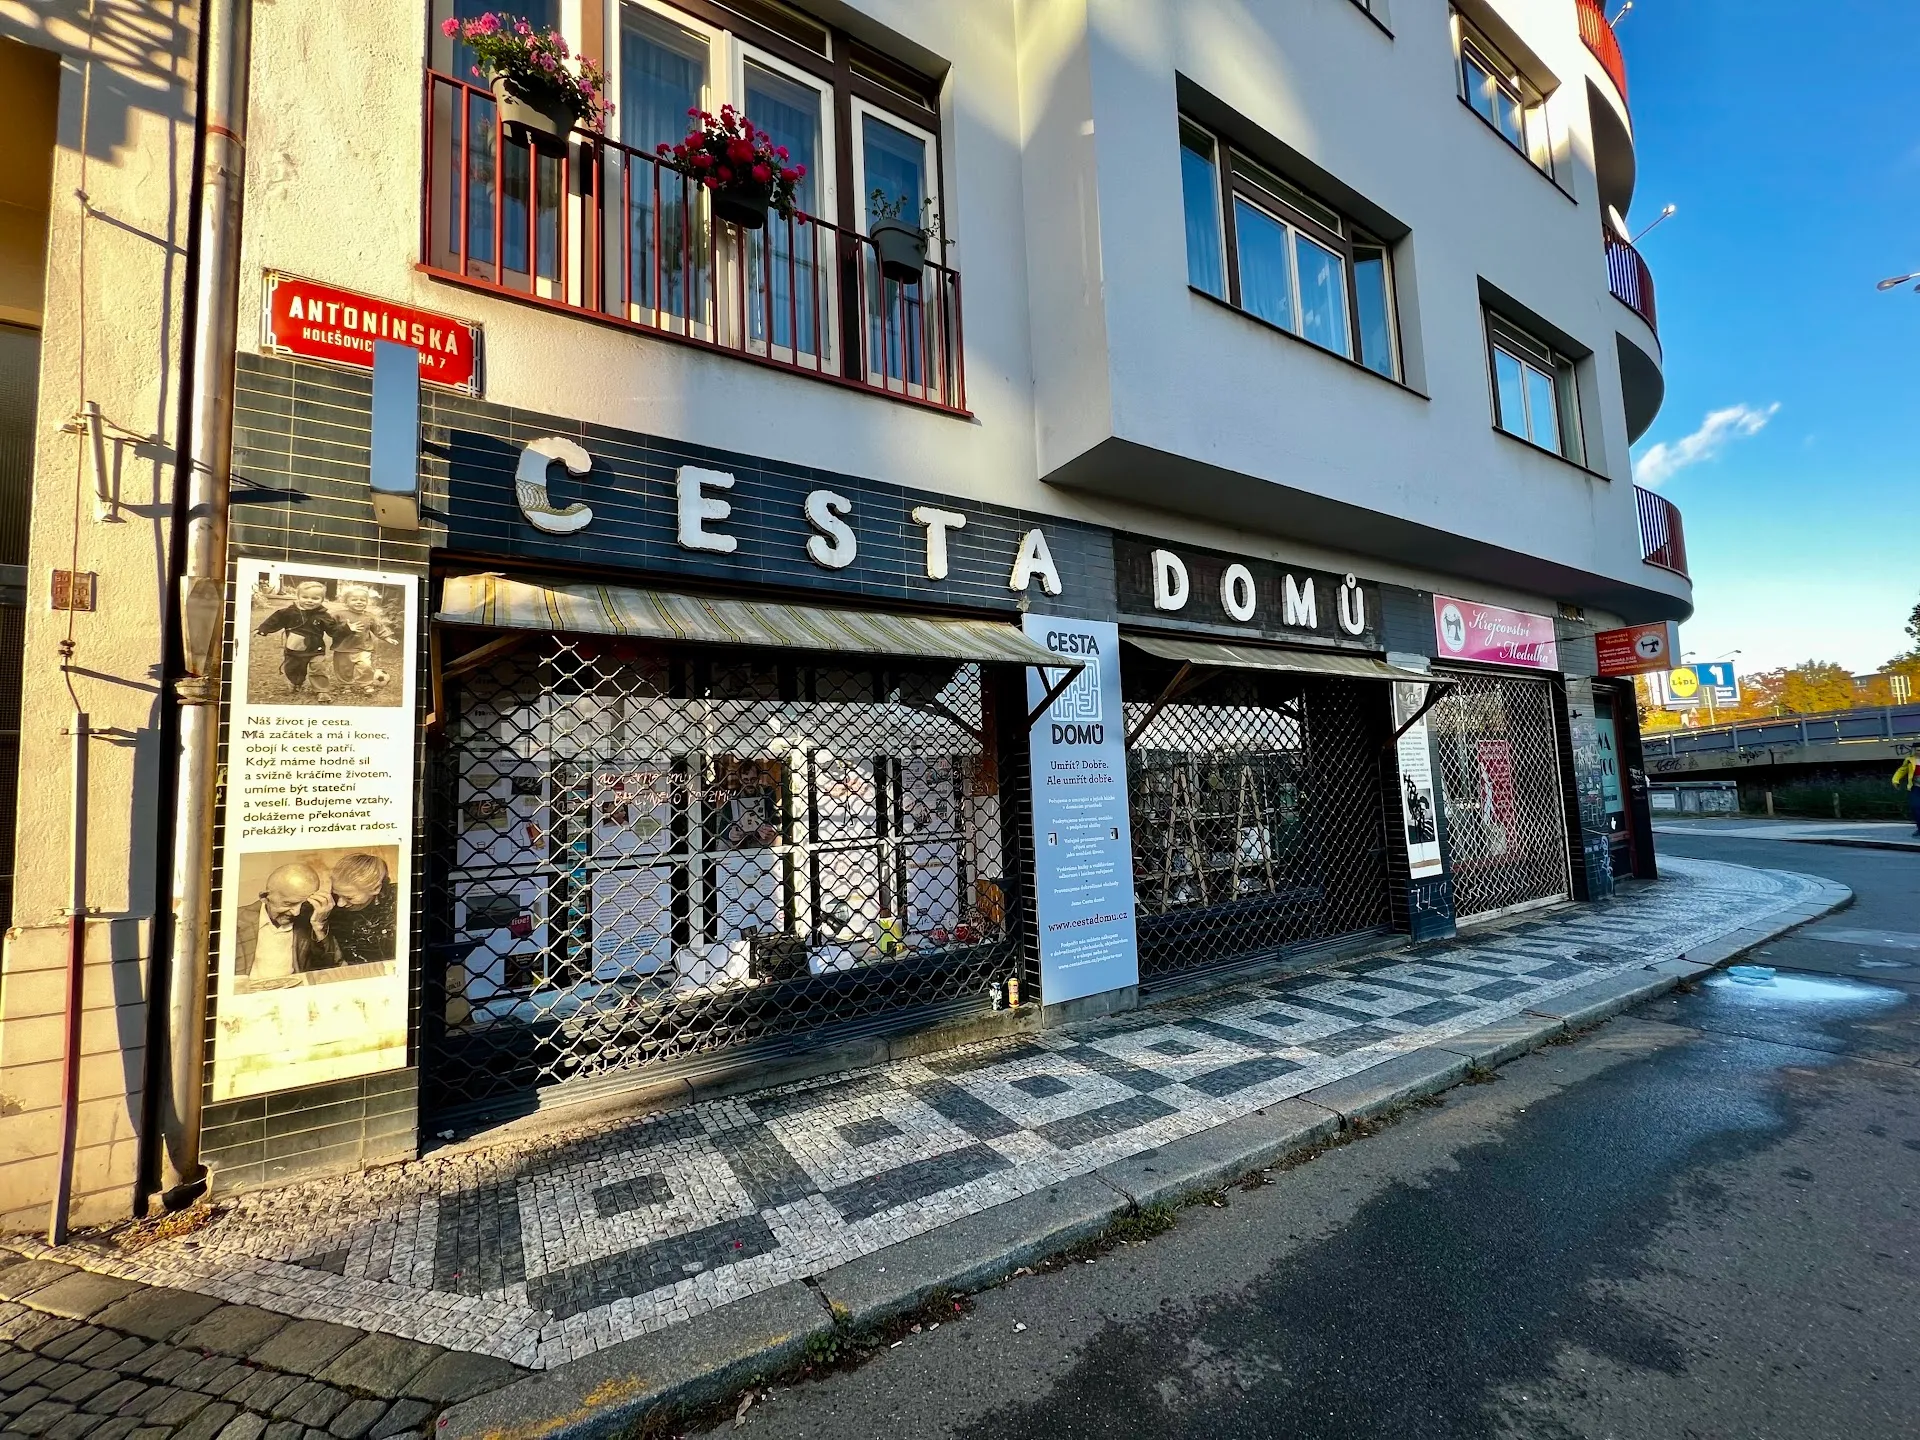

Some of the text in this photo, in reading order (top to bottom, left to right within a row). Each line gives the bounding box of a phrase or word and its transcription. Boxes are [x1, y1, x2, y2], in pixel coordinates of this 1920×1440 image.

[288, 295, 459, 356] ANTONÍNSKÁ
[303, 327, 374, 353] HOLEŠOVIC
[439, 357, 446, 369] 7
[514, 436, 1365, 636] CESTA DOMŮ
[1046, 630, 1100, 655] CESTA
[247, 716, 271, 726] Náš
[276, 716, 304, 726] život
[307, 717, 318, 728] je
[241, 730, 265, 739] Má
[269, 730, 313, 739] začátek
[327, 730, 343, 739] má
[1051, 723, 1104, 745] DOMŮ
[246, 743, 277, 755] obojí
[281, 743, 289, 752] k
[292, 743, 323, 753] cestě
[246, 757, 276, 769] Když
[280, 757, 316, 766] máme
[320, 756, 355, 766] hodně
[1050, 759, 1109, 770] Umřít? Dobře.
[256, 770, 292, 780] svižně
[296, 770, 342, 779] kráčíme
[1047, 773, 1114, 785] Ale umřít dobře.
[244, 782, 356, 795] umíme být stateční
[295, 797, 352, 808] Budujeme
[243, 809, 371, 822] dokážeme překonávat
[242, 825, 297, 839] překážky
[308, 823, 357, 833] rozdávat
[1048, 912, 1128, 932] www.cestadomu.cz
